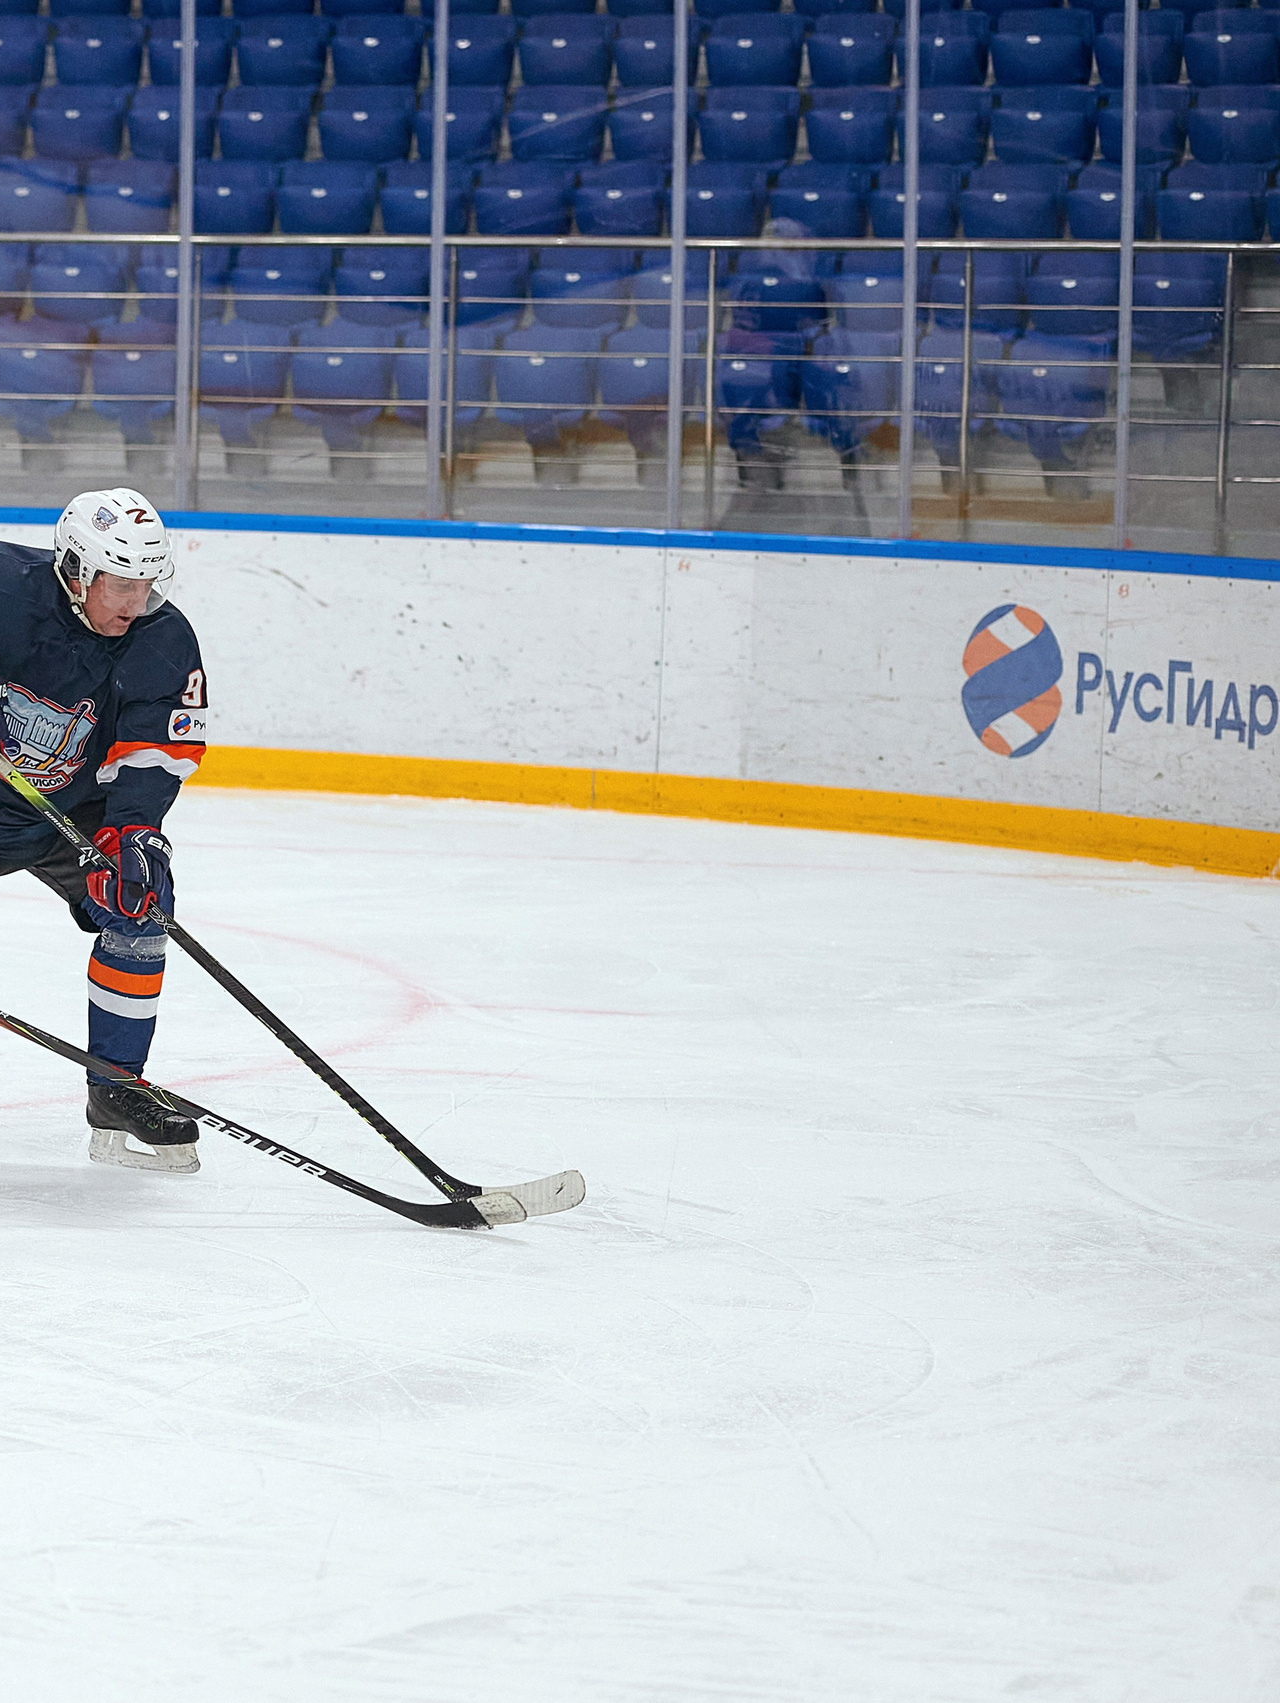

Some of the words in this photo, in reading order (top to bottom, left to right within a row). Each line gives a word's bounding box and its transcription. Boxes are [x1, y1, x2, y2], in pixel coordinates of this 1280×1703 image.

[68, 535, 86, 552] CCM
[141, 554, 167, 563] CCM
[181, 668, 204, 708] 9
[1075, 651, 1279, 750] РусГидр
[194, 1113, 328, 1178] BAUER
